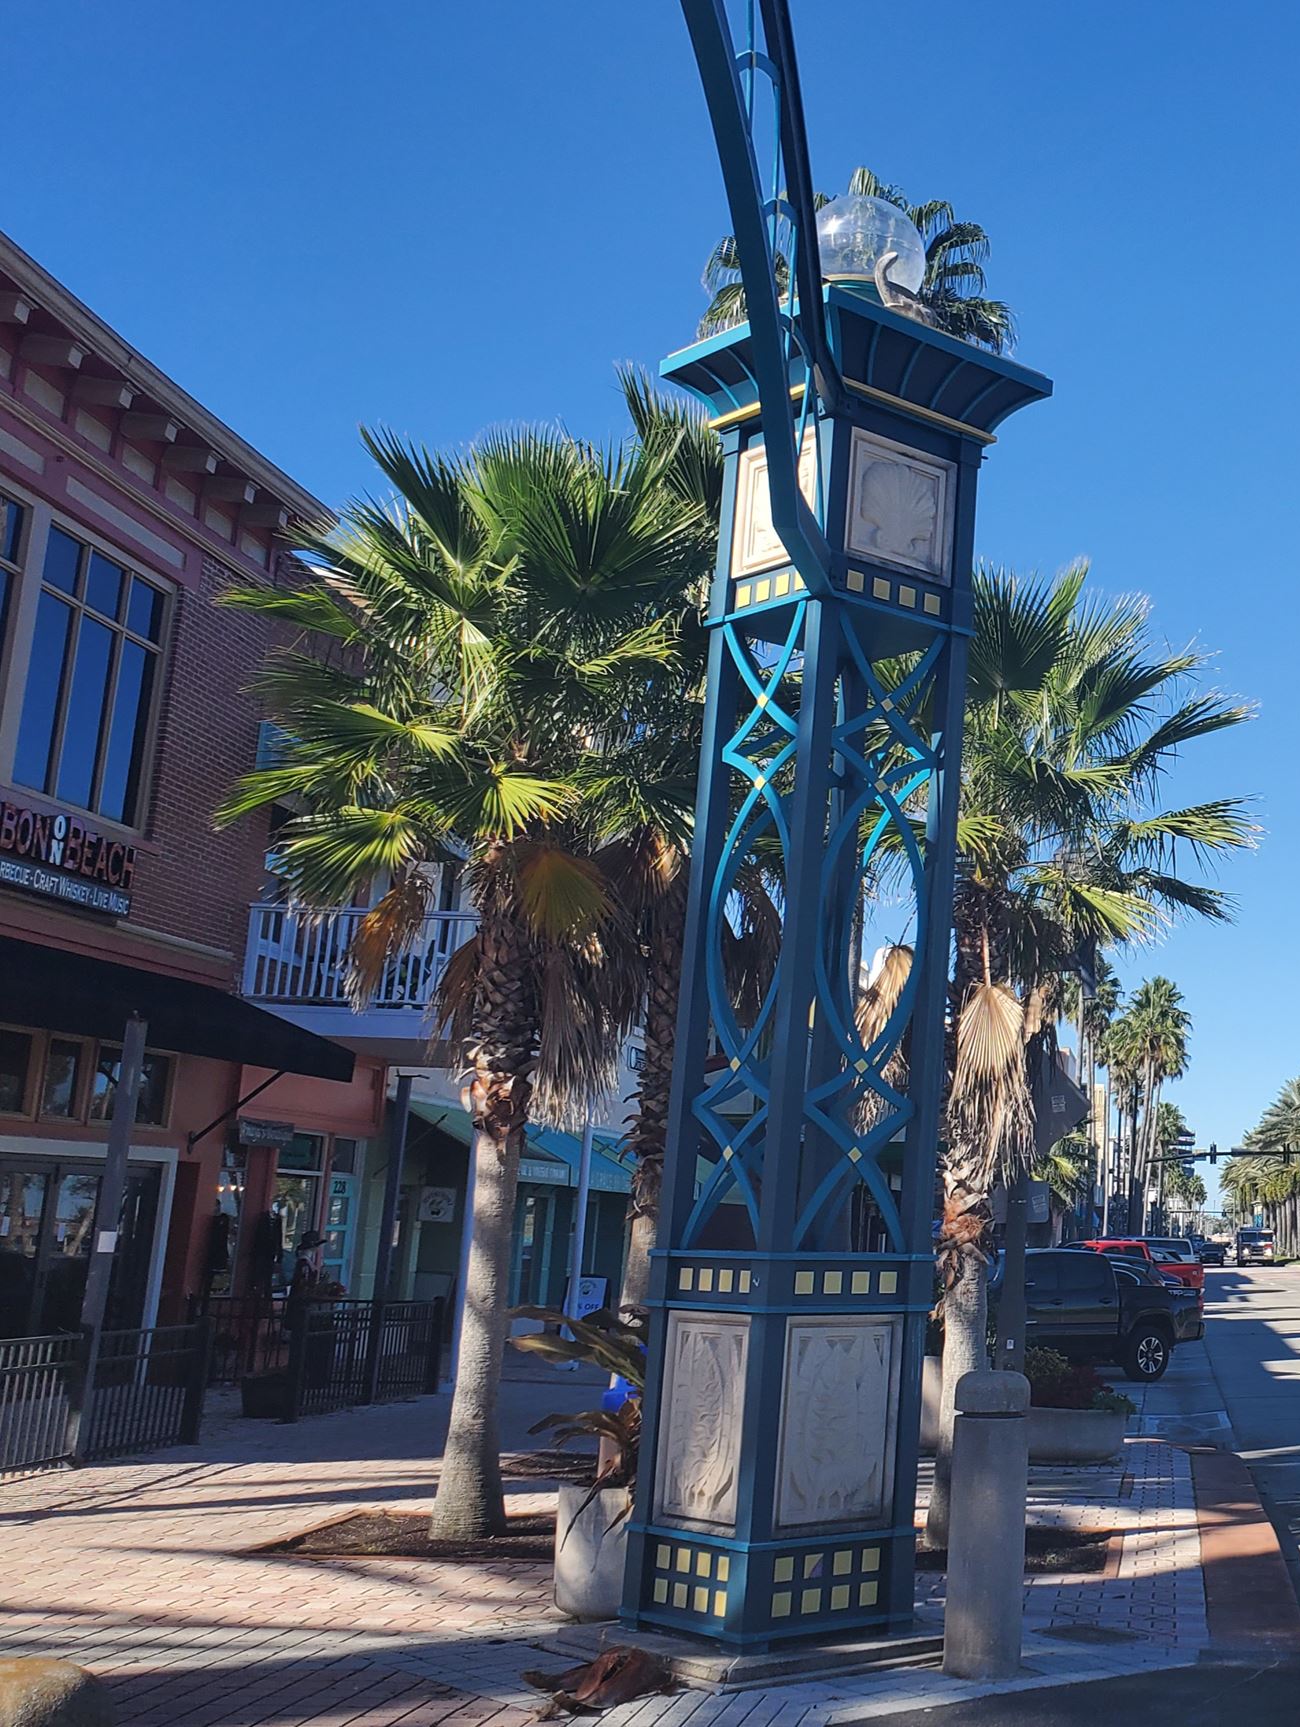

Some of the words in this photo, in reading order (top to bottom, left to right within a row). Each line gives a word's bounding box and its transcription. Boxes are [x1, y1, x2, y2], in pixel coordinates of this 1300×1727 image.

[49, 815, 66, 866] ON
[64, 816, 136, 888] BEACH
[33, 869, 59, 893] CRAFT
[59, 876, 91, 902] WHISKEY
[92, 887, 109, 909] LIVE
[109, 893, 130, 915] MUSIC
[333, 1181, 346, 1194] 228
